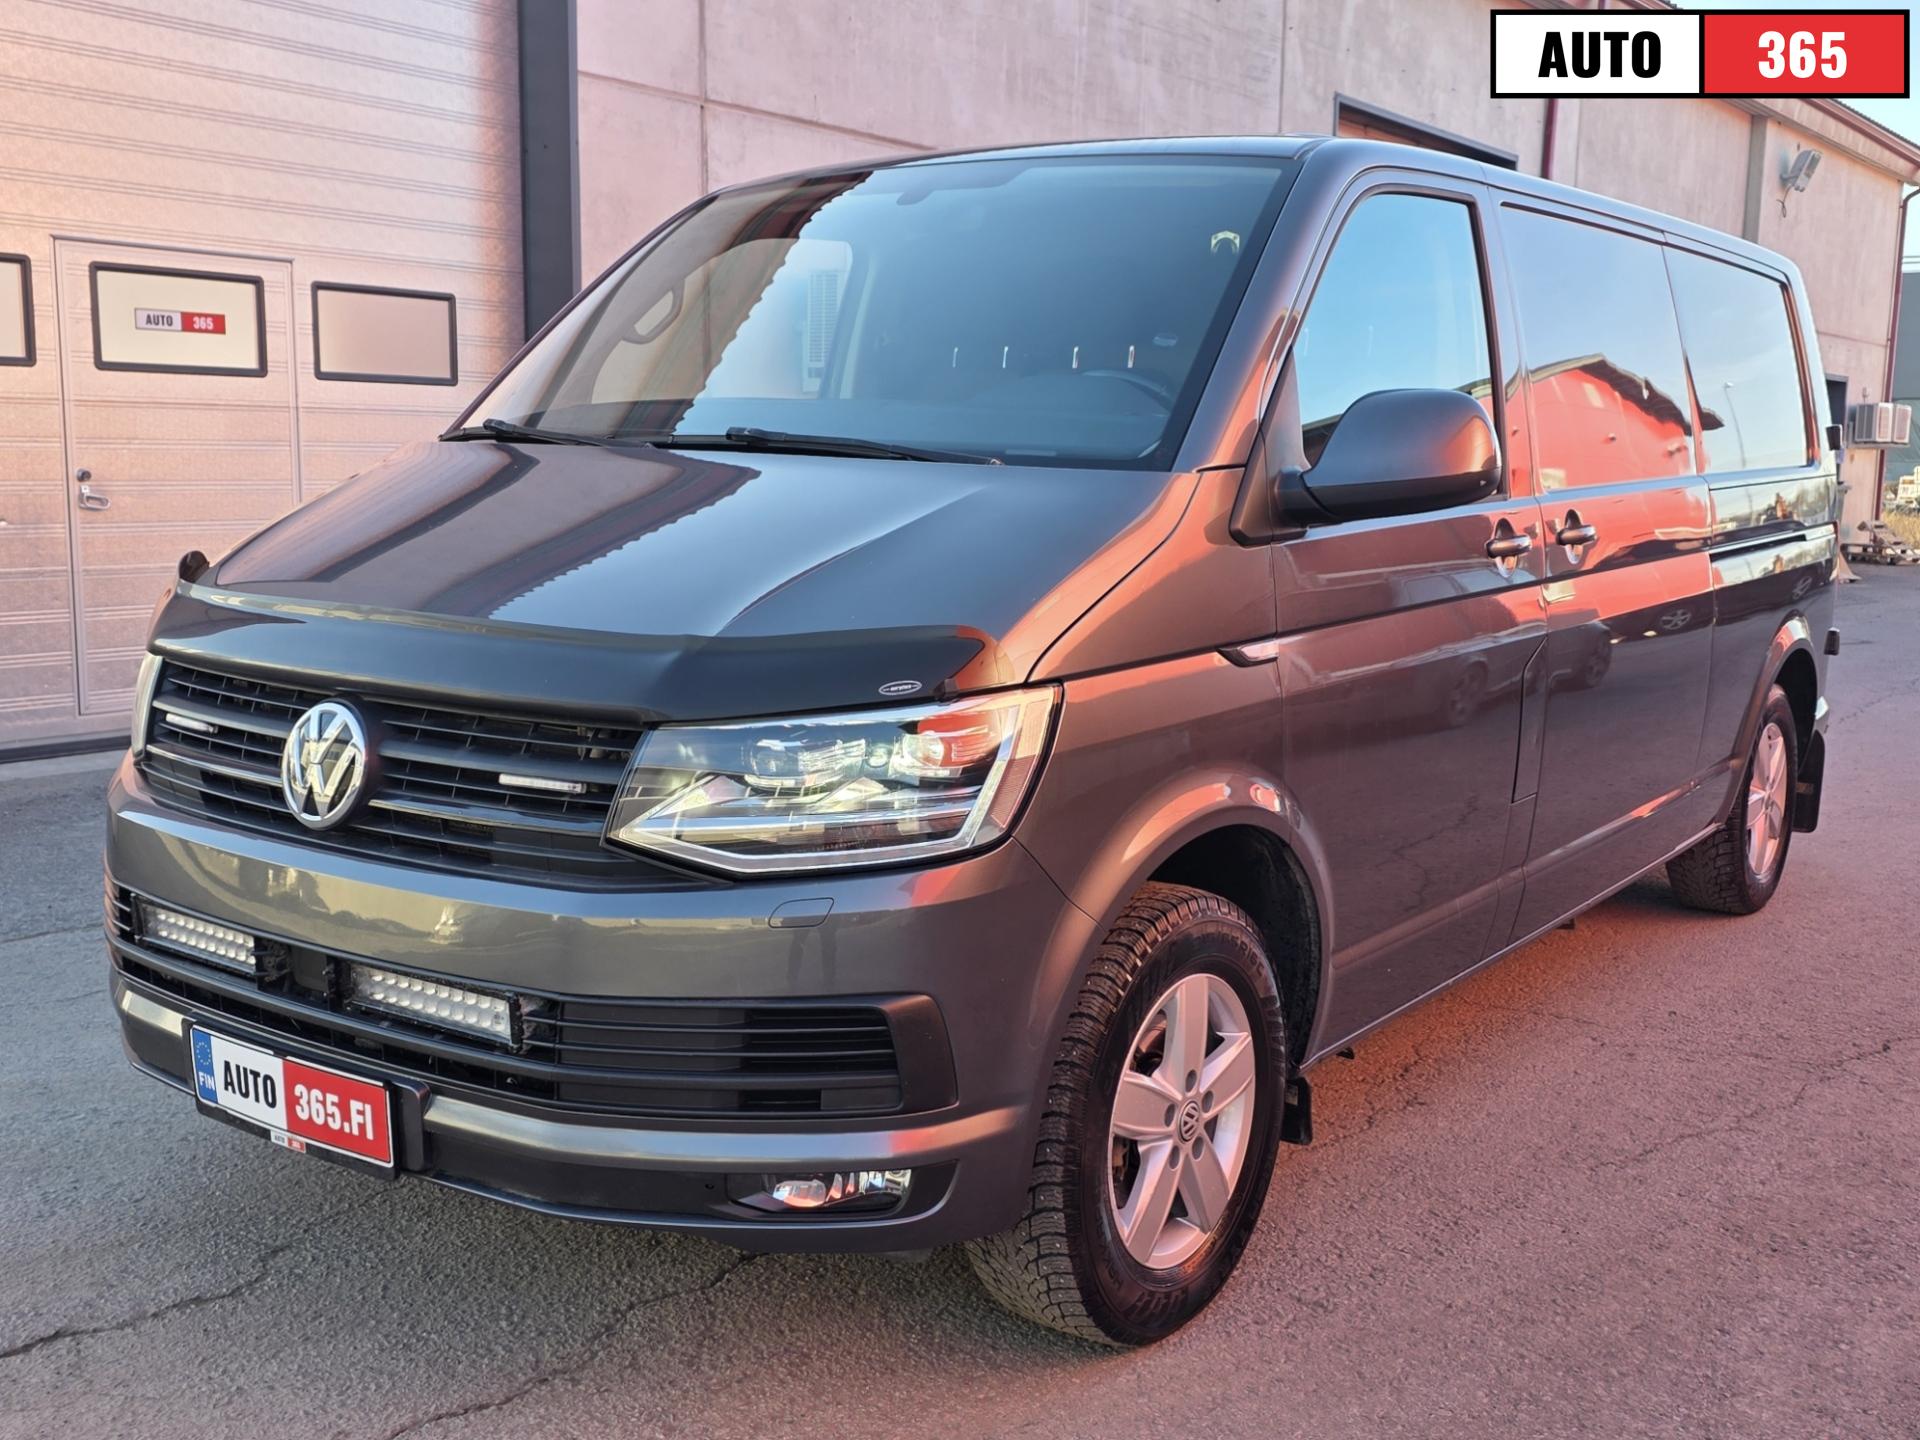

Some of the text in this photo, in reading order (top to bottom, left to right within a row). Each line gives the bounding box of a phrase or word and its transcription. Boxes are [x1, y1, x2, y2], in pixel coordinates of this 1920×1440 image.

[145, 313, 214, 330] AUTO 365
[199, 1071, 216, 1091] FIN
[223, 1060, 374, 1140] AUTO 365.FI
